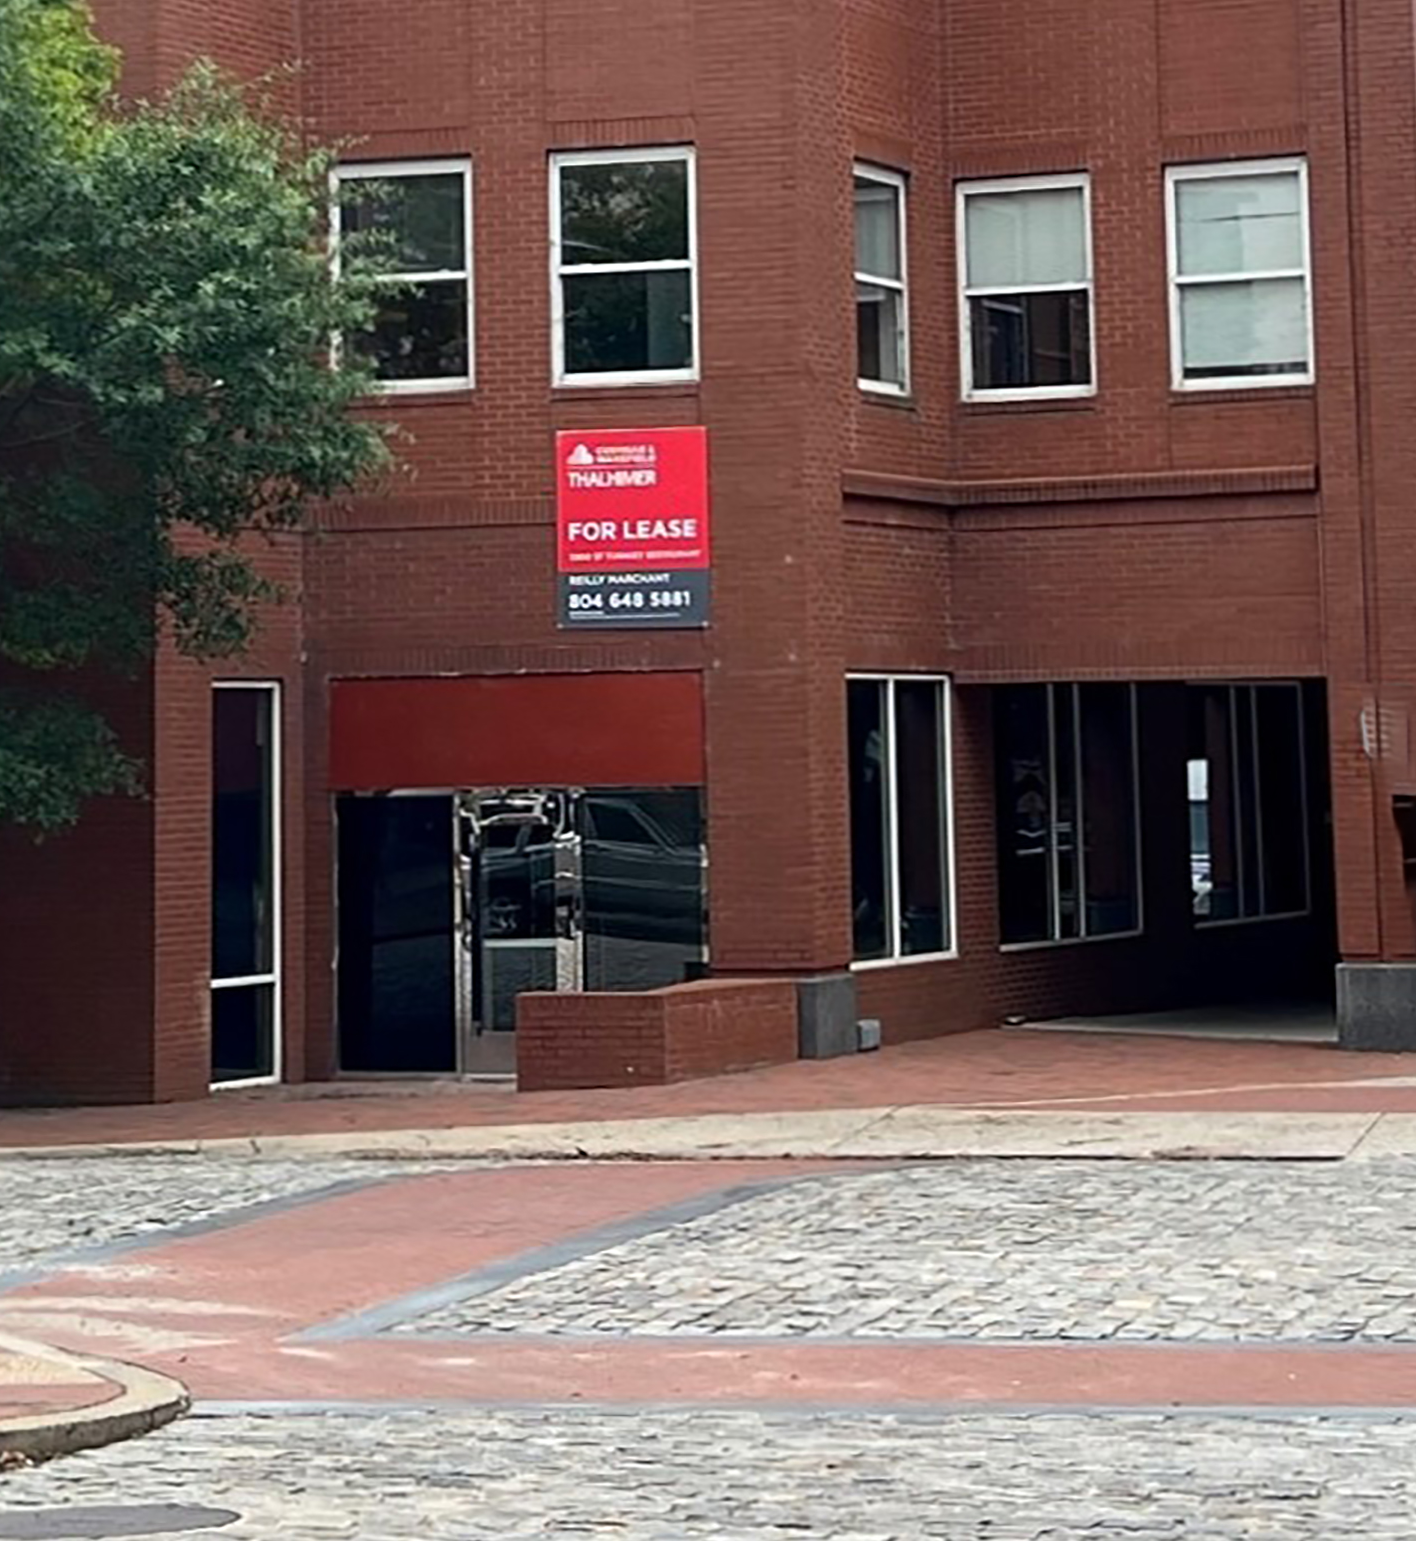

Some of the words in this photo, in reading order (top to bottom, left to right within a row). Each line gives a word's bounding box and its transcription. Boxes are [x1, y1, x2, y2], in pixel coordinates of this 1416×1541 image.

[568, 521, 617, 541] FOR
[623, 518, 697, 539] LEASE
[569, 593, 603, 609] 804
[609, 592, 644, 608] 648
[650, 590, 691, 607] 5881
